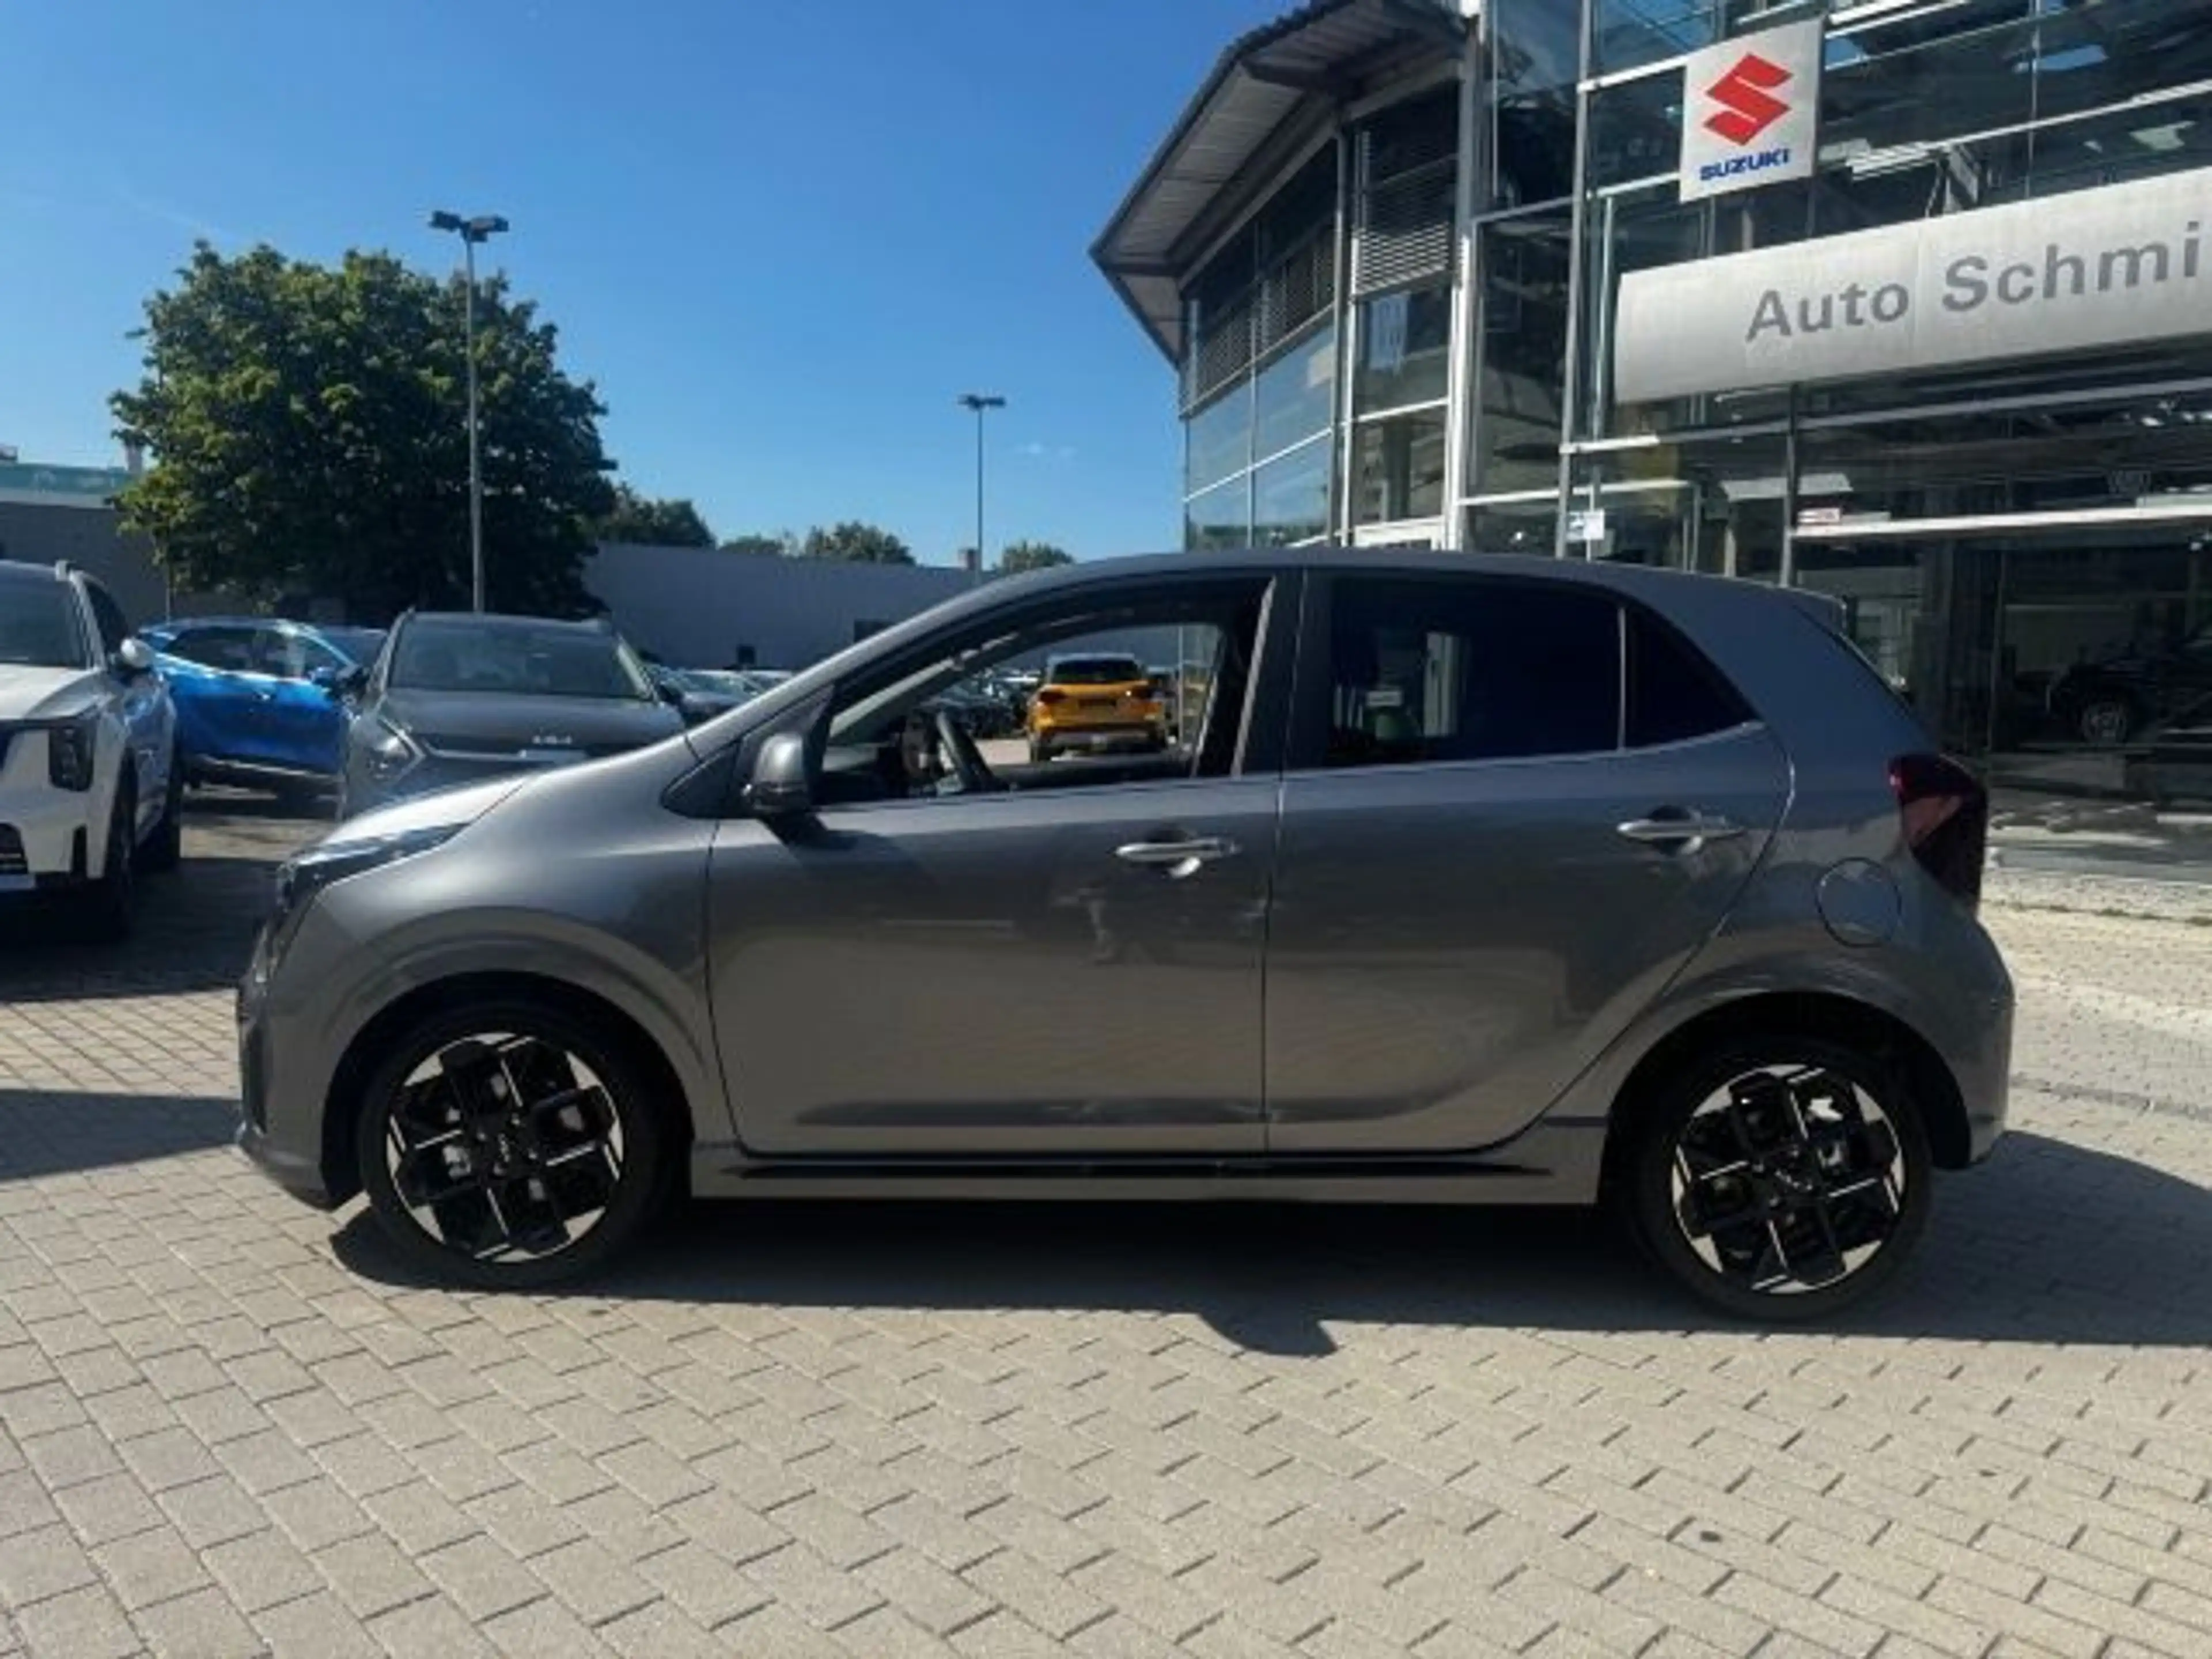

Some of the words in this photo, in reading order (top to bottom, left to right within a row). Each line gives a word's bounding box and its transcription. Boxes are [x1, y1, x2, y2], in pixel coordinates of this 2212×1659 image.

[1700, 148, 1790, 181] SUZUKI
[1746, 282, 1909, 342] Auto
[1941, 221, 2200, 312] Schmi
